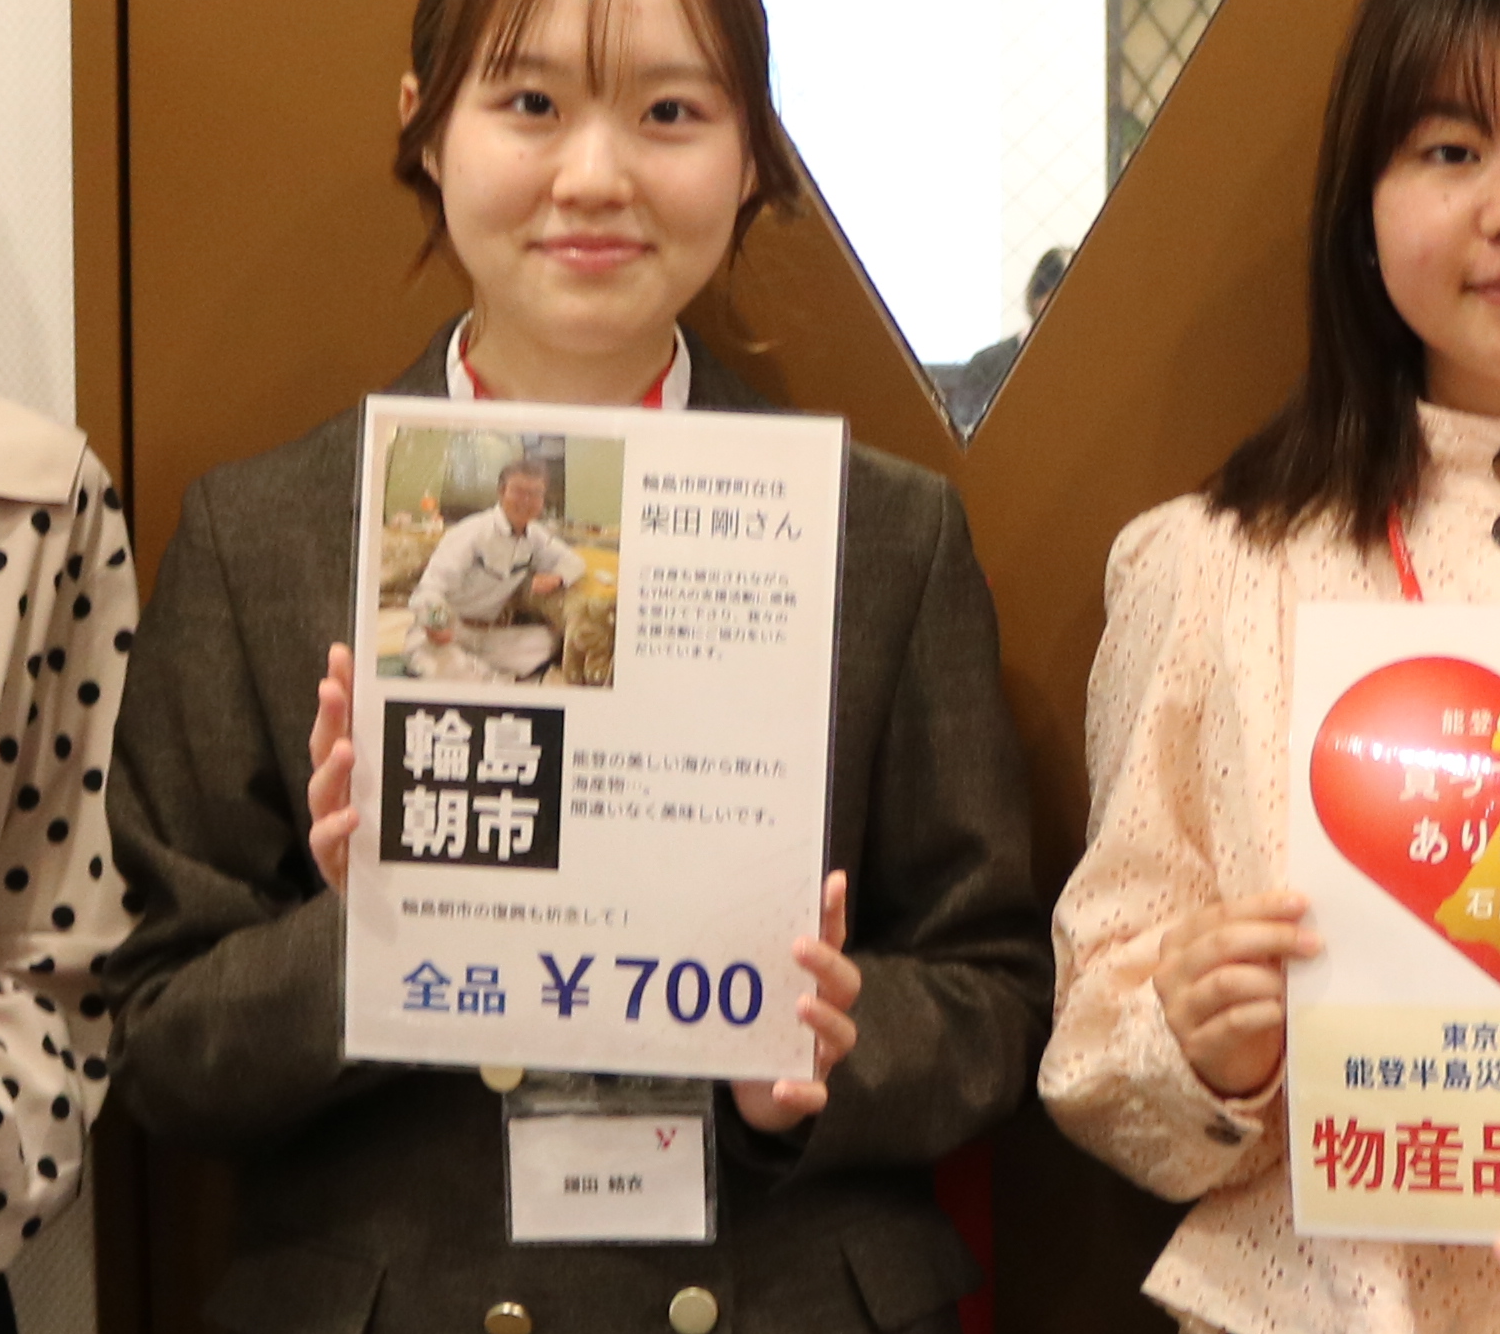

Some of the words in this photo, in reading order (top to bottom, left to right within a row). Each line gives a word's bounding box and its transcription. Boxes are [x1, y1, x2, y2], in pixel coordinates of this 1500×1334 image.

[402, 708, 543, 785] 輪島
[401, 784, 541, 862] 朝市
[402, 959, 507, 1016] 全品
